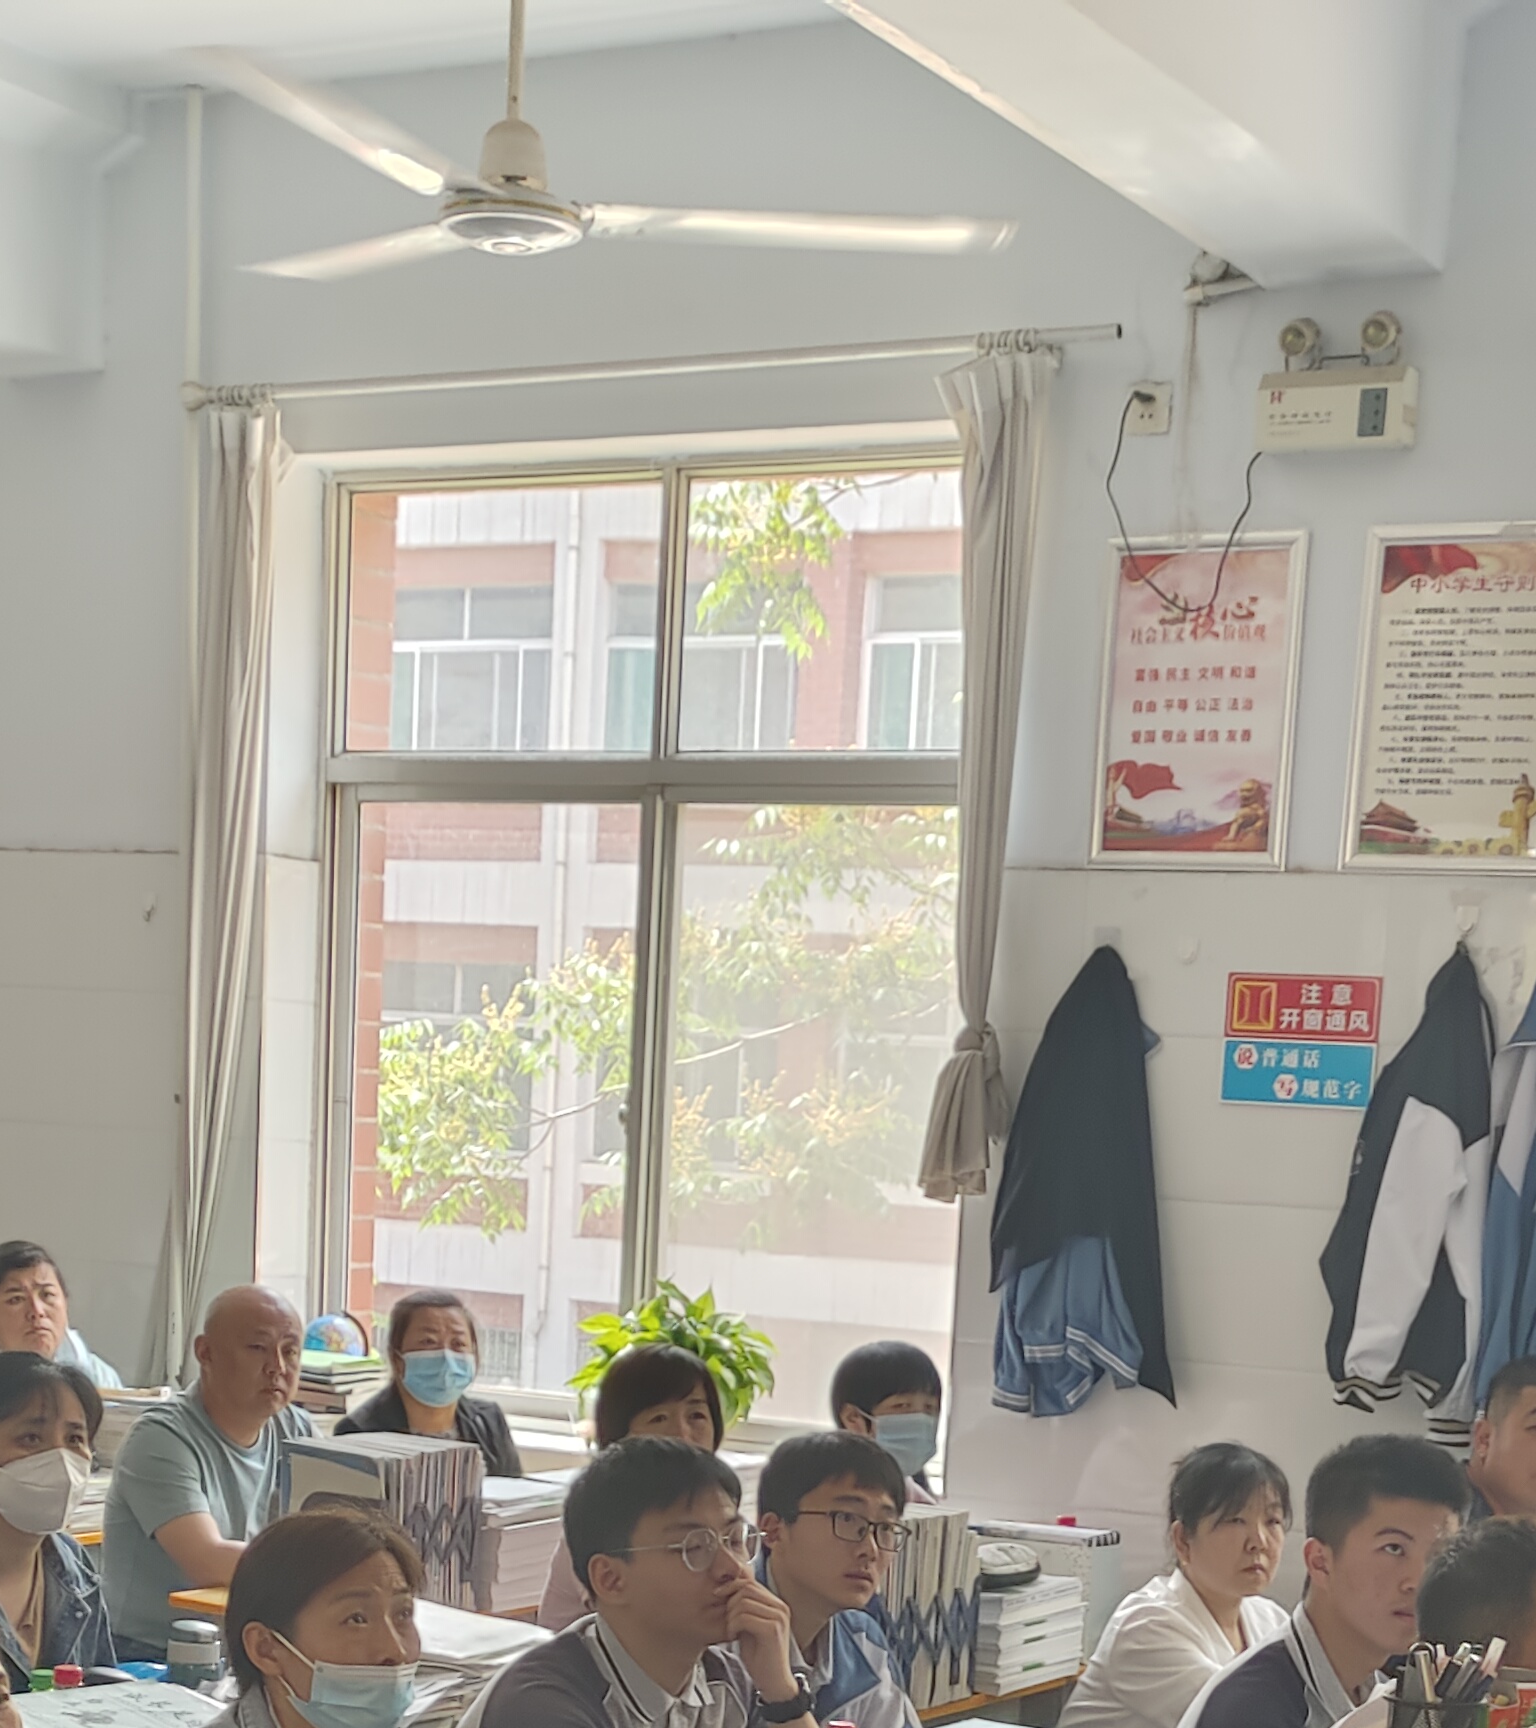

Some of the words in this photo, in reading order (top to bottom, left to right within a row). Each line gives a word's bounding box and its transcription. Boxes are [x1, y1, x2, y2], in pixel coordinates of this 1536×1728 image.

[1410, 575, 1536, 594] 中小学生守则
[1166, 667, 1190, 681] 民主
[1198, 666, 1224, 680] 文明
[1230, 666, 1256, 679] 和谐
[1132, 700, 1157, 713] 自由
[1163, 699, 1188, 712] 平等
[1195, 698, 1221, 711] 公正
[1227, 698, 1253, 711] 法治
[1131, 730, 1156, 743] 爱国
[1162, 730, 1187, 742] 敬业
[1194, 730, 1219, 742] 诚信
[1225, 729, 1251, 742] 友善
[1300, 983, 1353, 1006] 注意
[1279, 1008, 1370, 1033] 开窗通风
[1236, 1046, 1321, 1069] 说普通话
[1275, 1077, 1363, 1100] 写规范字
